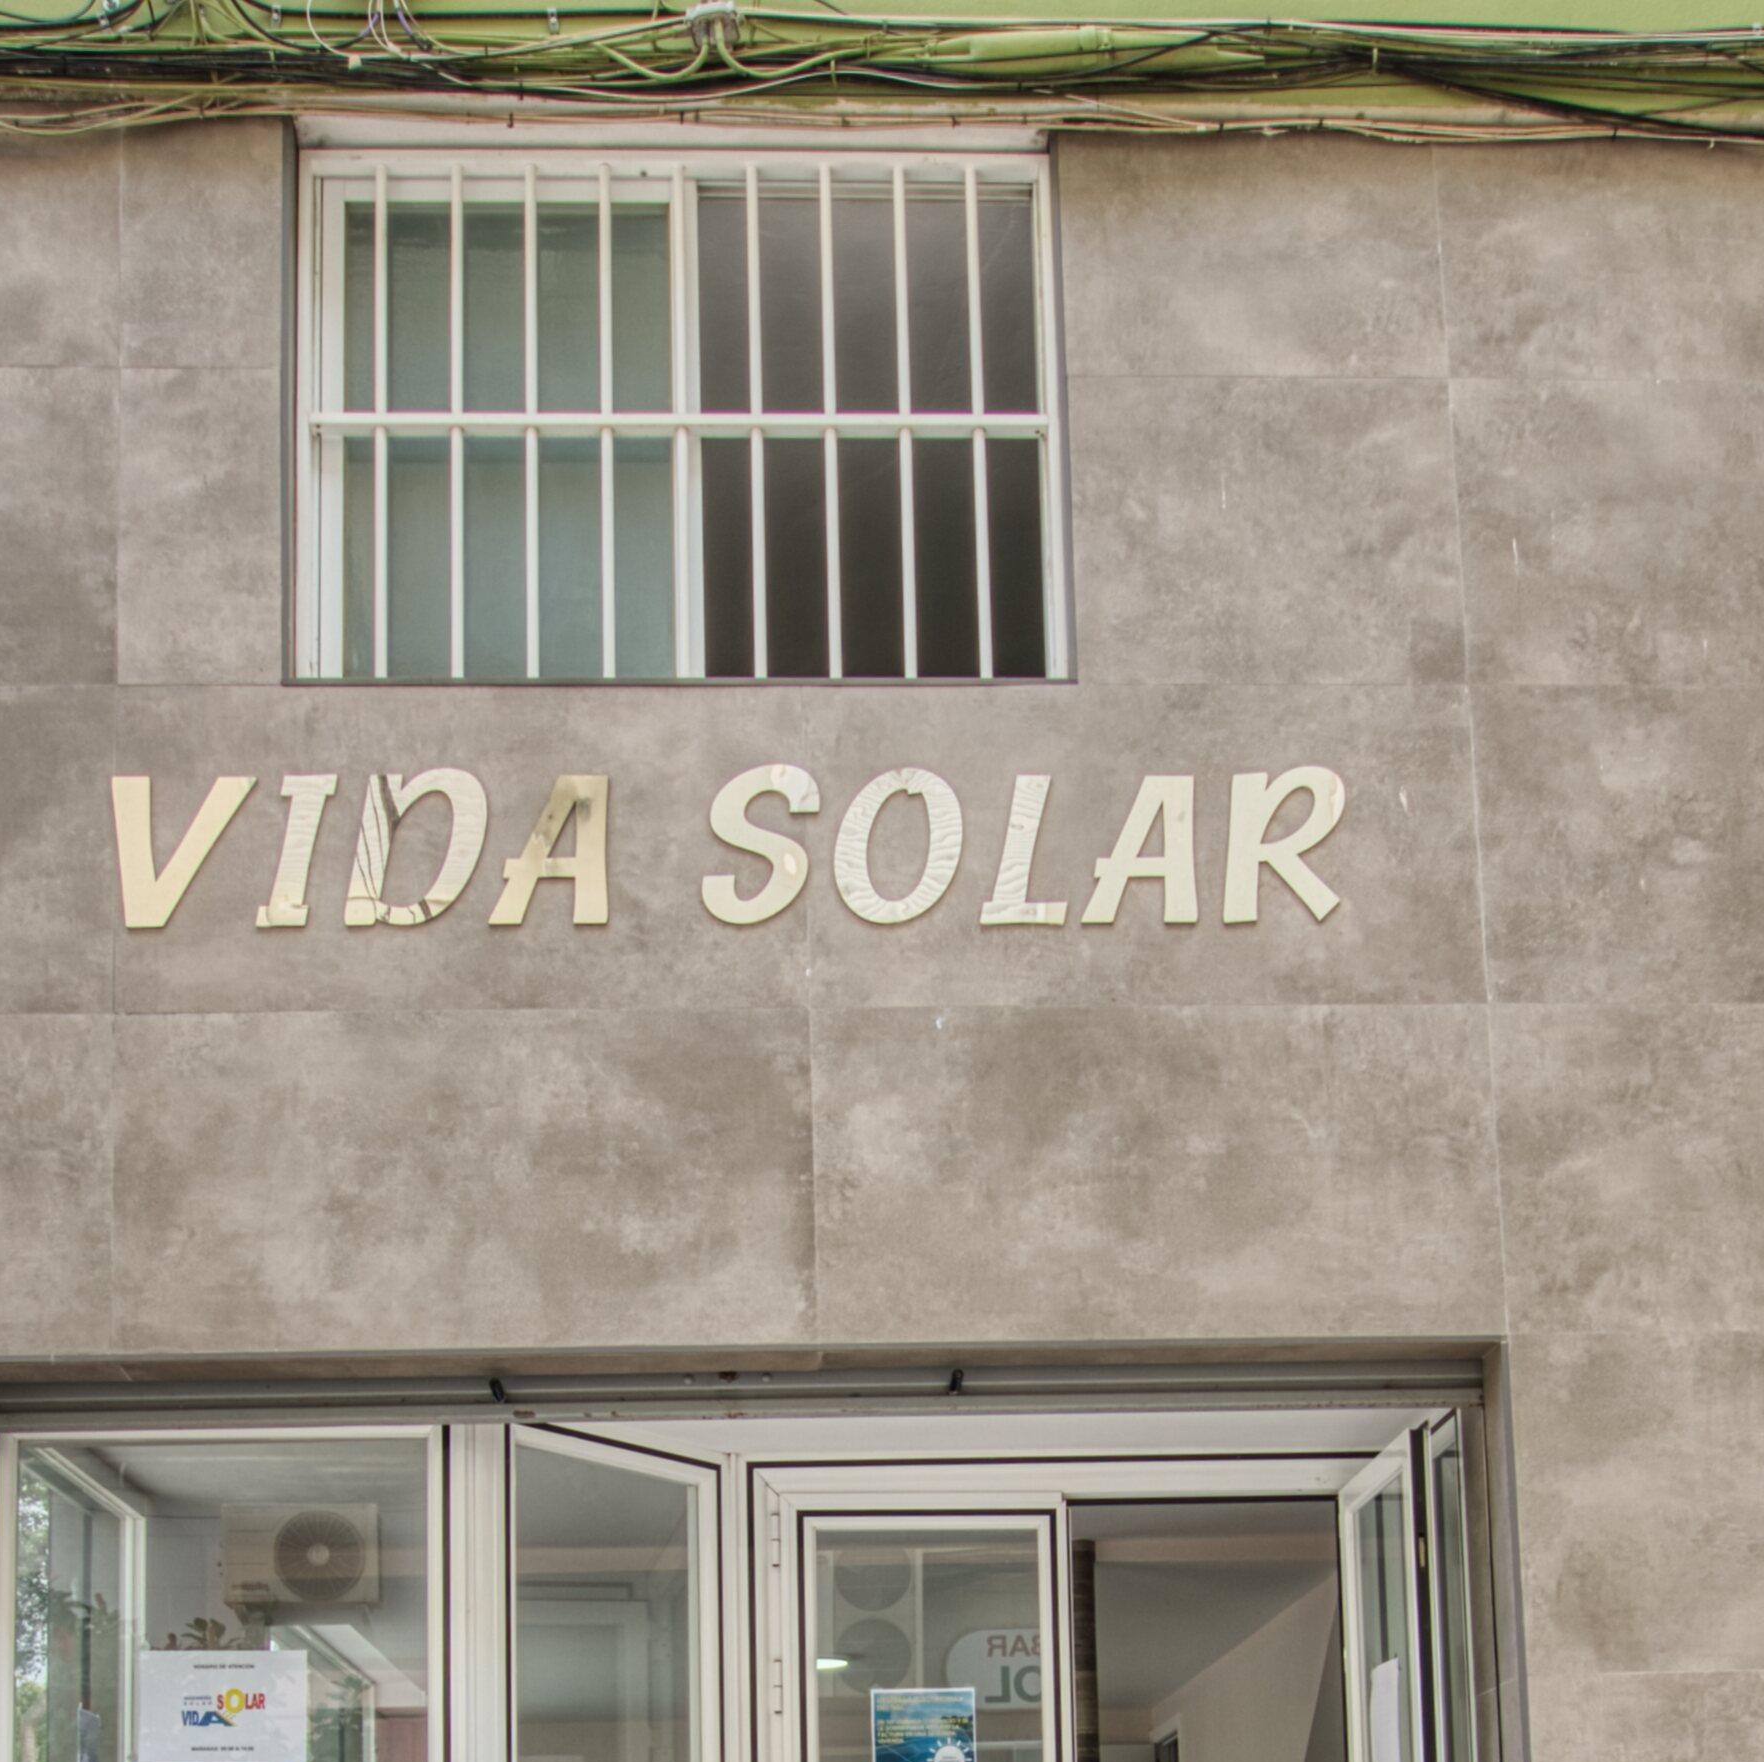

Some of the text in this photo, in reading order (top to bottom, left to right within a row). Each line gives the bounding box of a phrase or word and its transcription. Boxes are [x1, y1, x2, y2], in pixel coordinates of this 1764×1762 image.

[109, 762, 1347, 929] VIDA SOLAR
[181, 1688, 265, 1726] VIDA SOLAR
